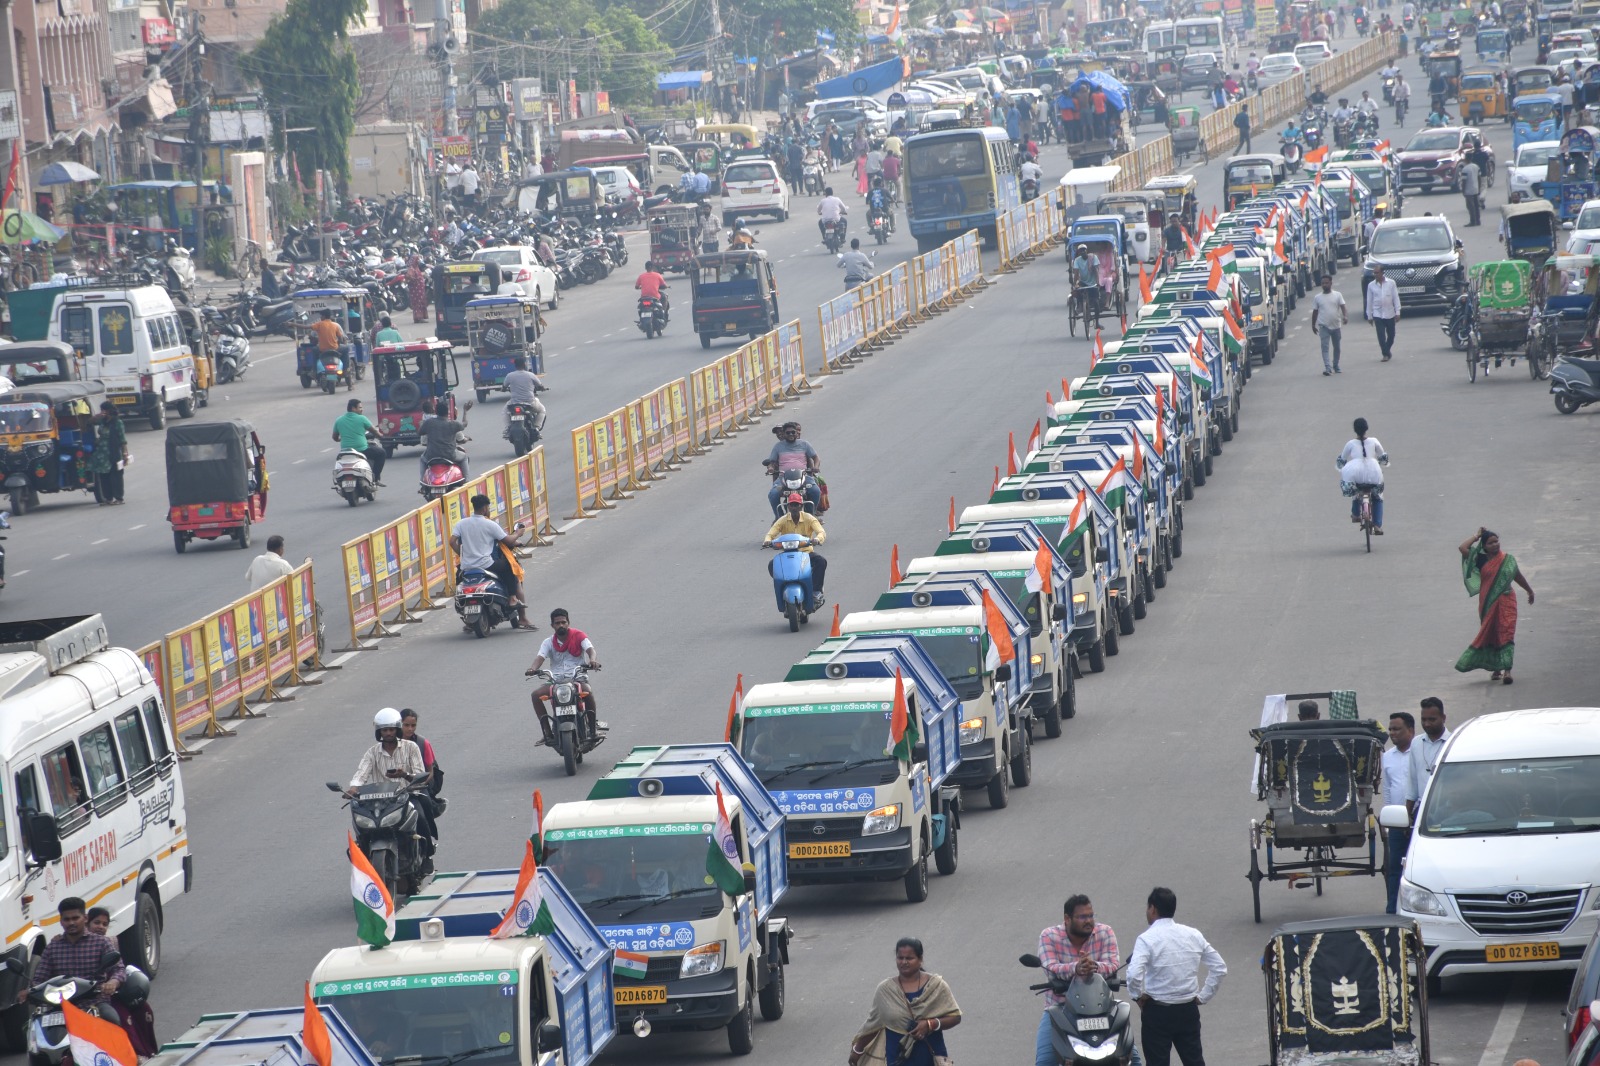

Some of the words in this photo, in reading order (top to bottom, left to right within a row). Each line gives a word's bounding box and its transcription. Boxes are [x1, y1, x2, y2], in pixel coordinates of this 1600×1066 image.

[443, 144, 469, 157] LODGE
[488, 327, 508, 339] ATUL
[138, 789, 168, 817] TRAVELLER
[796, 844, 850, 856] OD02DA6826
[62, 844, 90, 889] WHITE
[89, 828, 118, 873] SAFARI
[1493, 947, 1506, 959] OD
[1509, 946, 1522, 958] 02
[1524, 946, 1530, 957] P
[1532, 944, 1557, 957] 8515
[502, 986, 515, 996] 11
[616, 989, 665, 1002] 02DA6870
